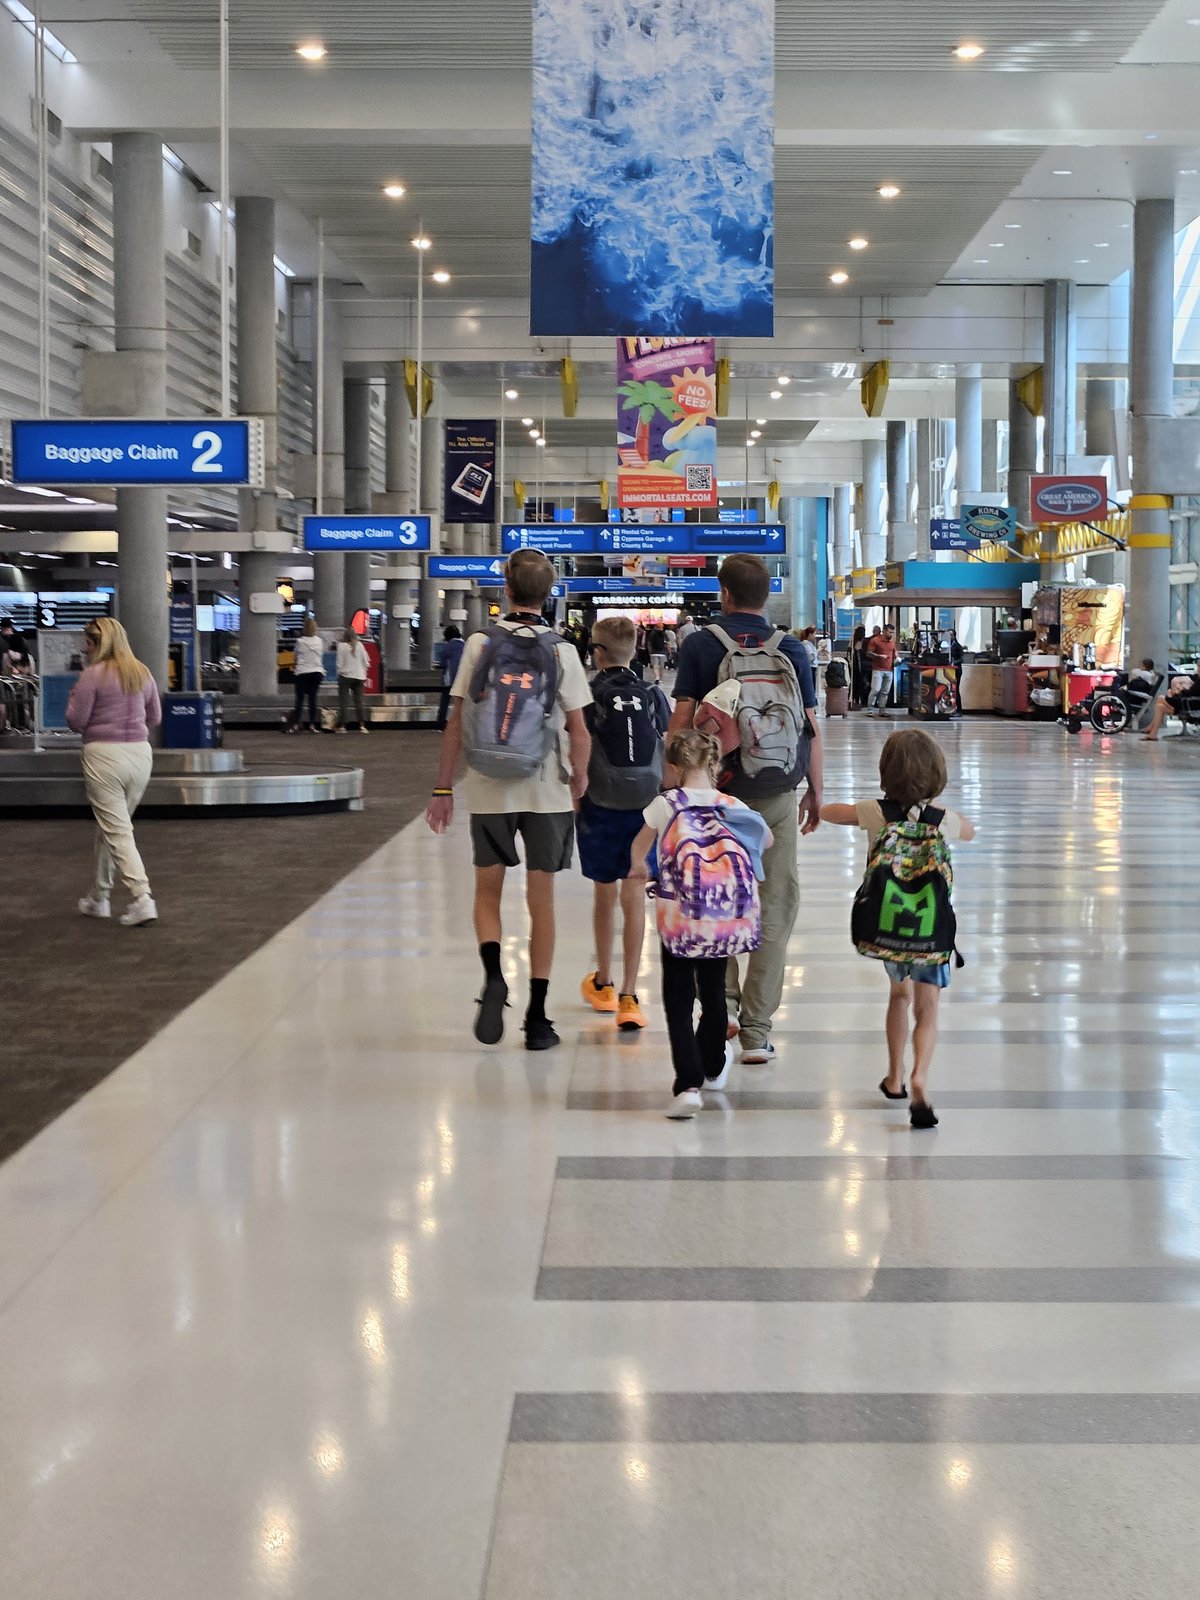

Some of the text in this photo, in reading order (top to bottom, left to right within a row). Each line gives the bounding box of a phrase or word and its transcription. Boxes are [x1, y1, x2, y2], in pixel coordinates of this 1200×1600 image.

[656, 359, 686, 370] THEATER
[686, 385, 706, 396] NO
[678, 394, 711, 409] FEES!
[44, 430, 223, 473] Baggage Claim 2
[622, 493, 711, 503] IMMORTALSEATS.COM
[1063, 492, 1097, 500] AMERICAN
[977, 507, 999, 516] KONA
[949, 522, 960, 530] Cou
[967, 524, 999, 539] BREWING
[320, 521, 418, 545] Baggage Claim 3
[438, 559, 502, 575] Baggage Claim 4
[550, 585, 560, 596] 6
[592, 594, 685, 605] STARBUCKS COFFEE
[41, 608, 56, 627] 3
